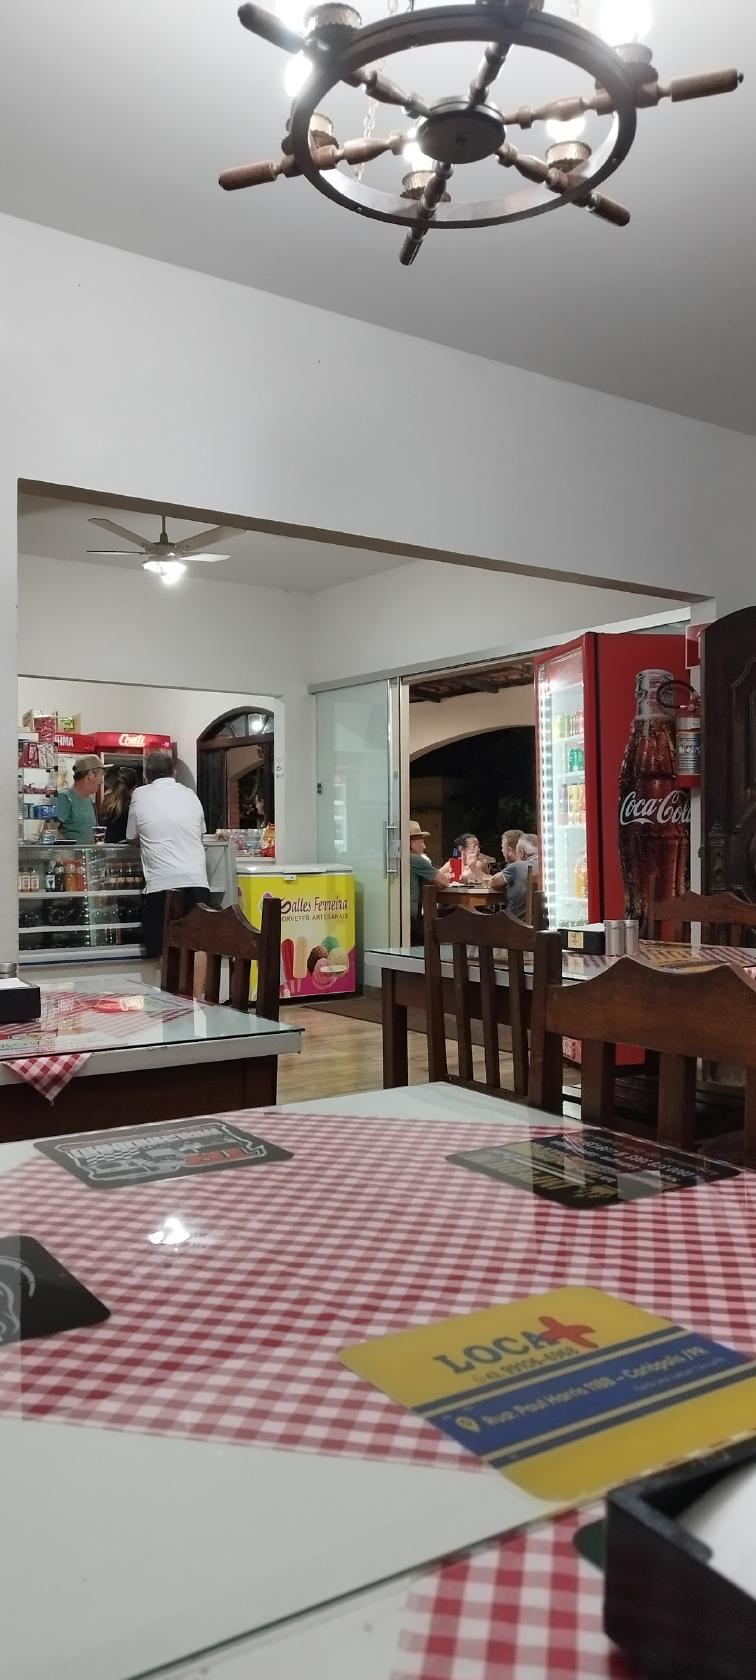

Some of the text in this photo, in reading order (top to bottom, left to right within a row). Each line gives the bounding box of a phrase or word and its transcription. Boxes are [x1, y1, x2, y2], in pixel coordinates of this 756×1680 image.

[281, 896, 348, 914] Salles Ferreira
[312, 912, 348, 921] ARTESANAIS
[514, 1396, 546, 1417] Paul
[546, 1384, 585, 1408] Harris
